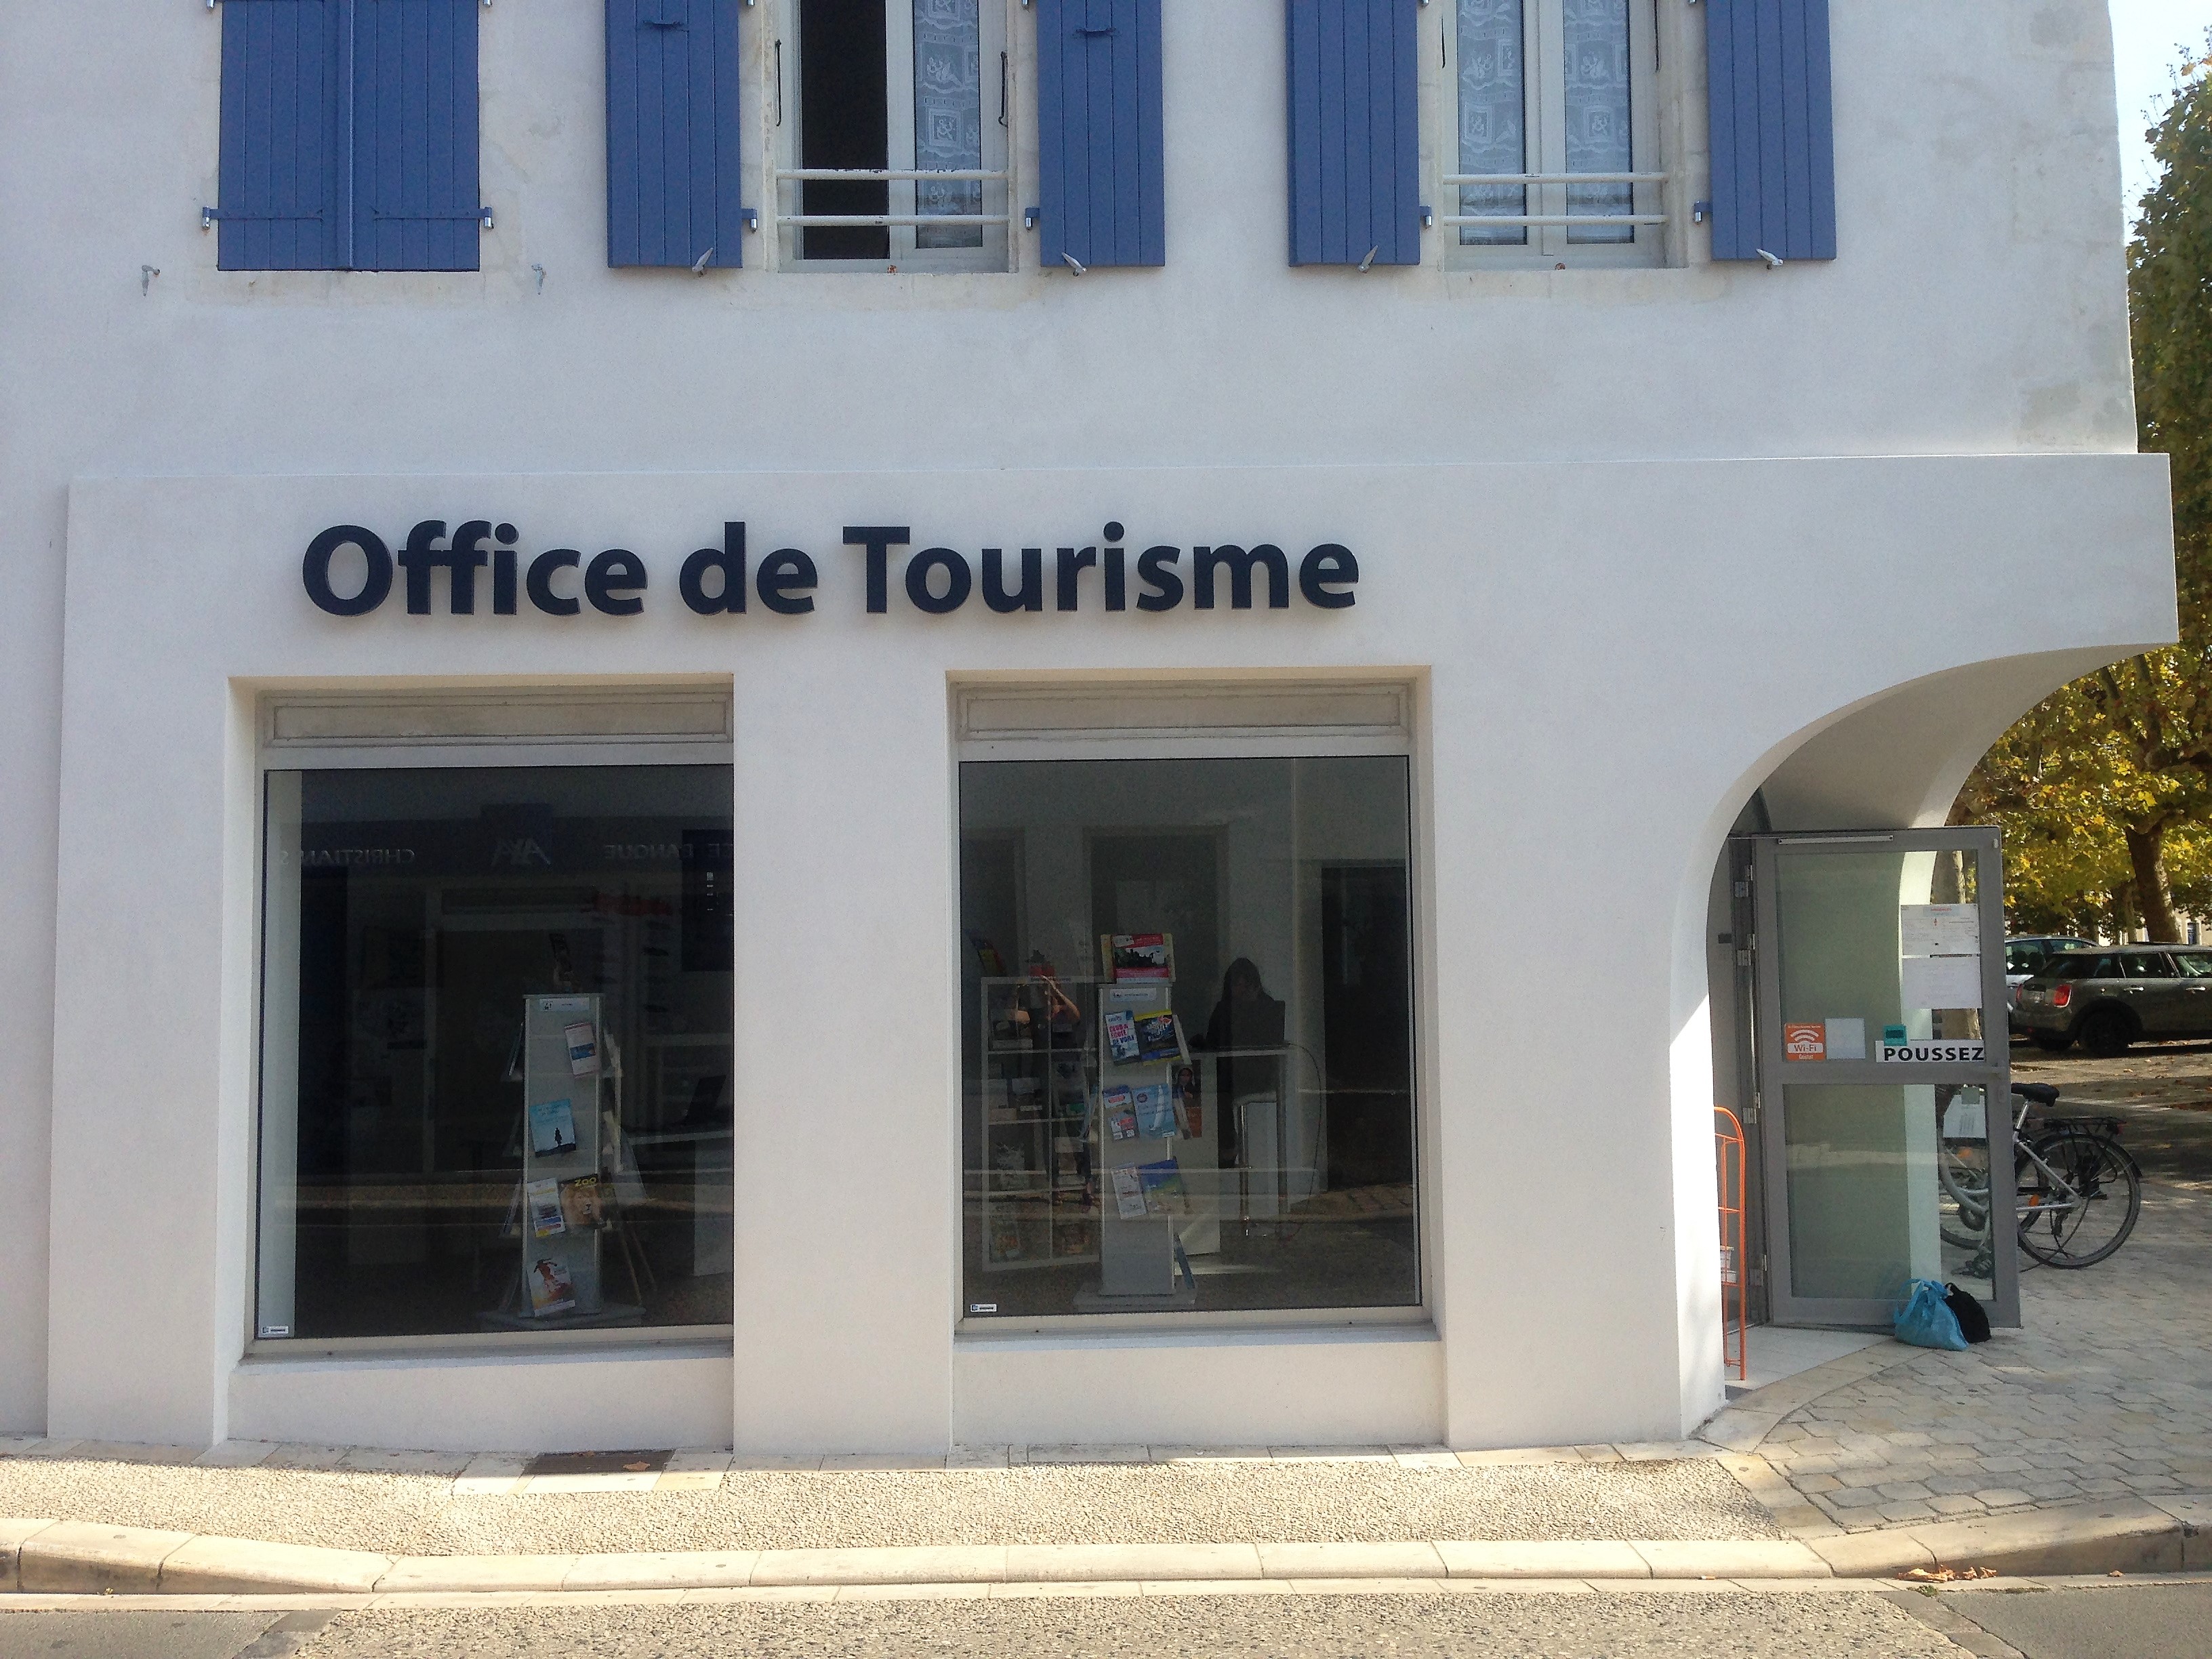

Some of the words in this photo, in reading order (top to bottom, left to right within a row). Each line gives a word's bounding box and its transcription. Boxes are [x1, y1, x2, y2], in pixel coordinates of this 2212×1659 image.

[302, 520, 649, 616] Office
[678, 521, 817, 615] de
[842, 521, 1359, 614] Tourisme
[1793, 1044, 1817, 1052] Wi-Fi
[1883, 1046, 1984, 1062] POUSSEZ
[574, 1176, 597, 1187] ZOO
